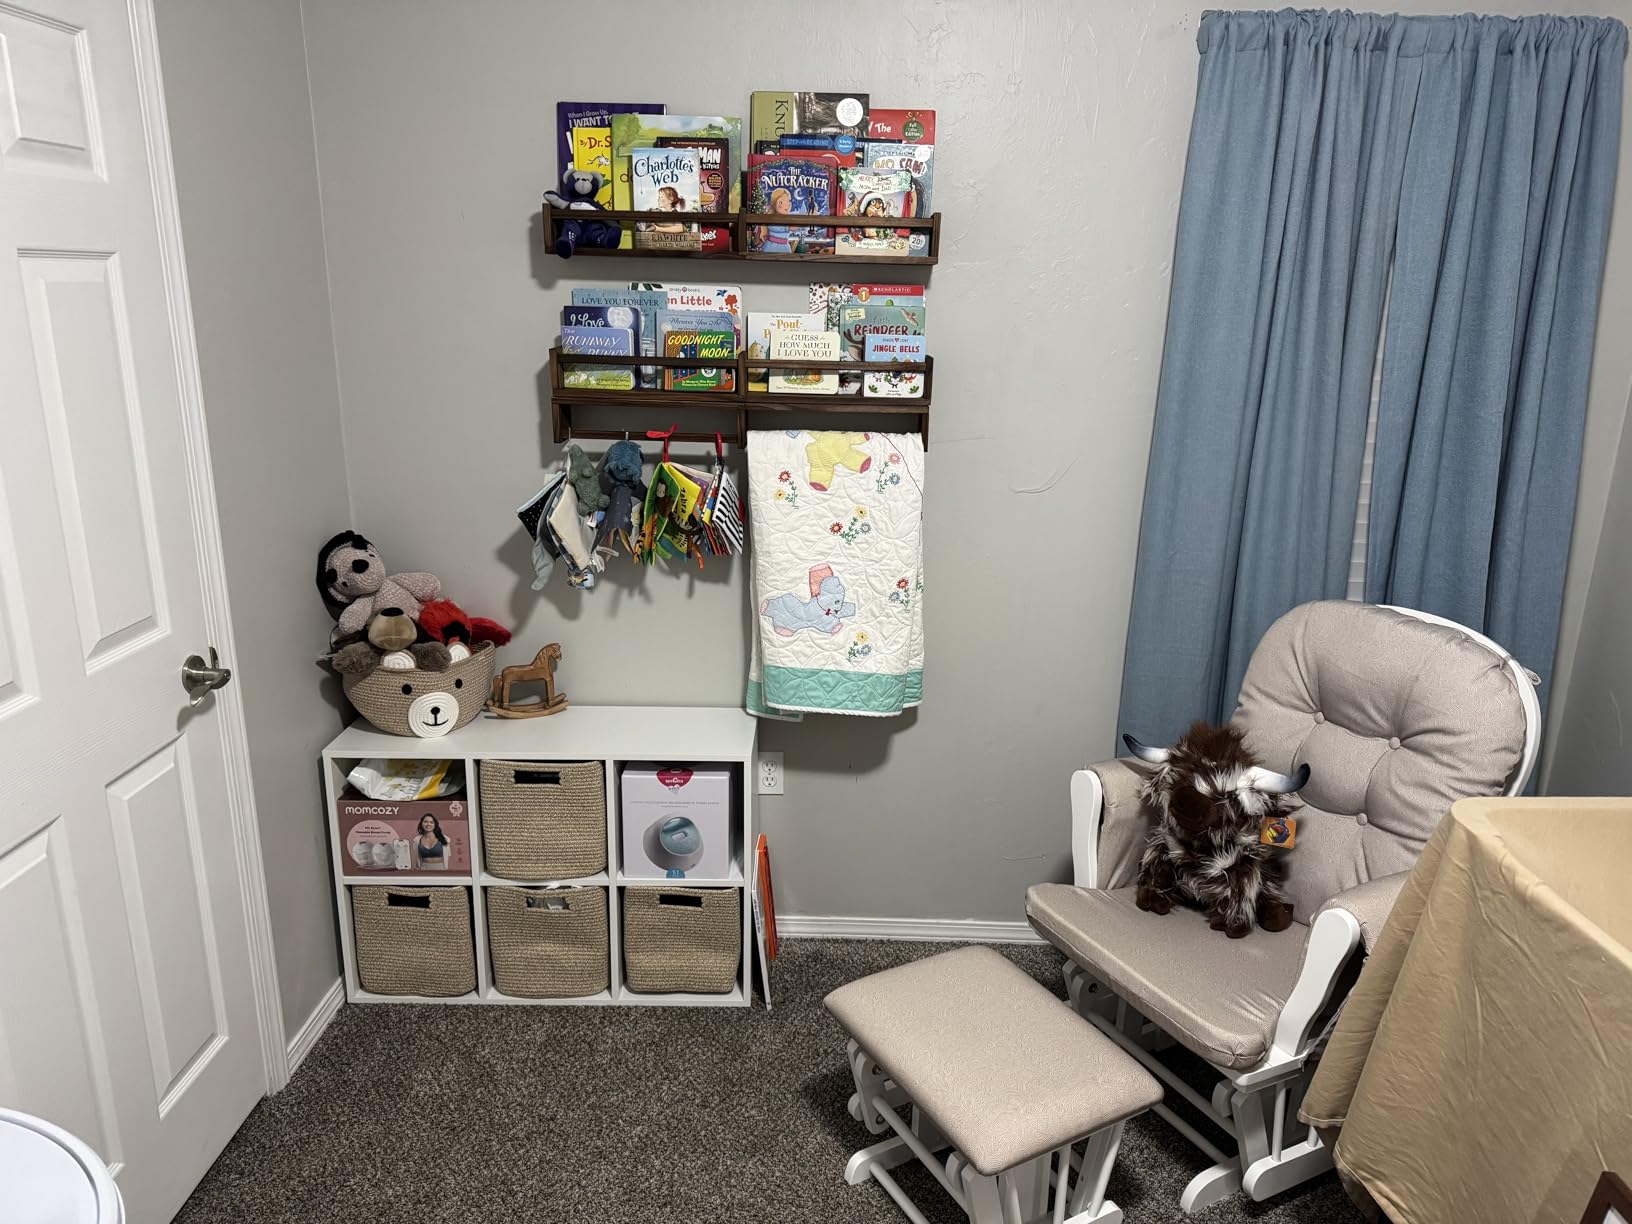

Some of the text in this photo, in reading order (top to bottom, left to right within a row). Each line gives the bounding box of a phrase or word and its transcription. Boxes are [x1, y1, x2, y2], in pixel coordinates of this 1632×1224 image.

[573, 116, 602, 128] WANT
[874, 122, 892, 133] The
[580, 140, 588, 148] By
[588, 136, 604, 150] Dr.
[698, 146, 722, 164] MAN
[634, 154, 694, 178] Charlotte's
[788, 166, 802, 176] THE
[651, 170, 679, 188] Web
[761, 172, 829, 190] NUTCRACKER
[662, 234, 688, 242] WHITE
[680, 296, 712, 306] Little
[861, 291, 866, 300] 1
[623, 298, 659, 306] FOREVER
[578, 313, 605, 328] Love
[564, 335, 621, 348] RUNAWAY
[668, 334, 726, 345] GOODNIGHT
[700, 348, 730, 357] MOON
